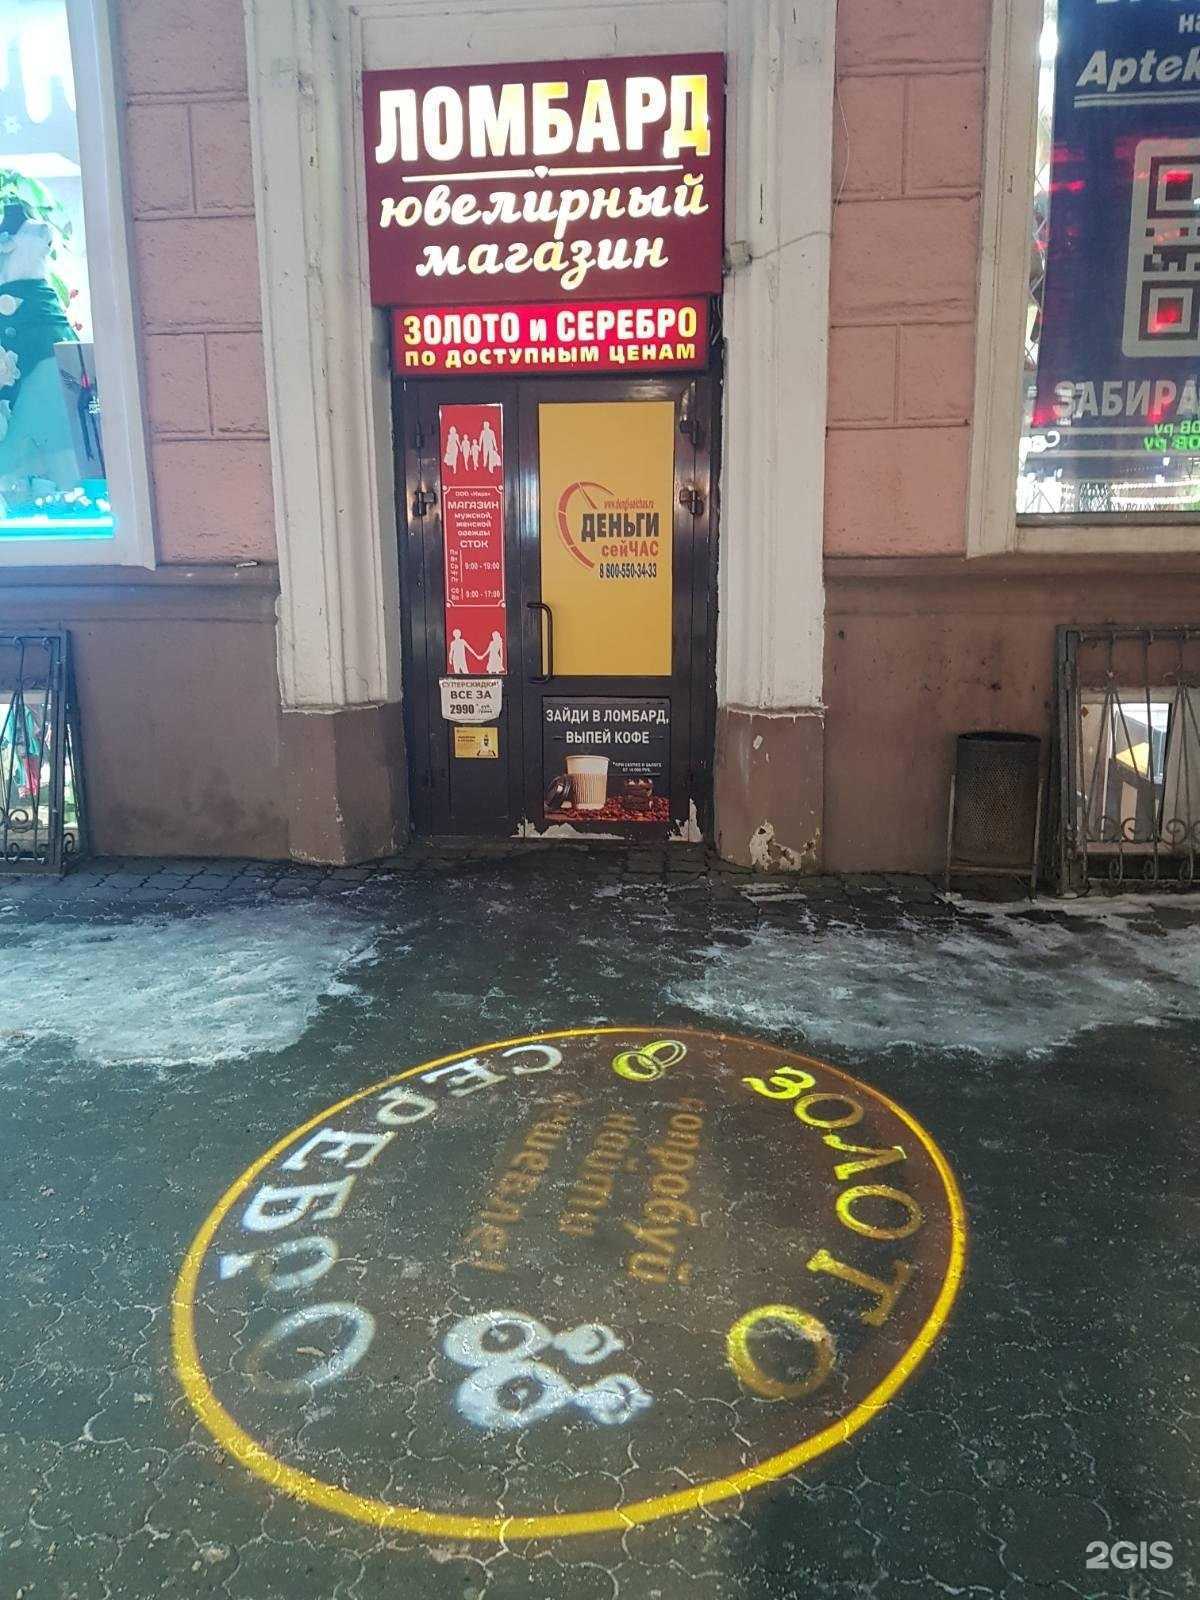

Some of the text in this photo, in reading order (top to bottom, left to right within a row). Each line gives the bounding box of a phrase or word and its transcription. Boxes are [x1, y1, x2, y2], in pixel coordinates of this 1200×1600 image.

[1178, 14, 1200, 34] н
[375, 74, 711, 164] ЛОМБАРД
[380, 173, 709, 240] ювелирный
[416, 237, 669, 291] магазин
[403, 307, 697, 345] ЗОЛОТО и СЕРЕБРО
[405, 343, 695, 368] ПО ДОСТУПНЫМ ЦЕНАМ
[1053, 380, 1200, 418] ЗАБИРА
[447, 501, 499, 510] МАГАЗИН
[581, 512, 659, 542] ДЕНЬГИ
[460, 540, 489, 548] СТОК
[601, 540, 659, 557] сейЧАС
[606, 563, 657, 578] 800-550-34-33
[450, 691, 492, 699] ВСЕ ЗА
[450, 704, 475, 714] 2990
[546, 706, 669, 724] ЗАЙДИ В ЛОМБАРД,
[566, 729, 649, 743] ВЫПЕЙ КОФЕ
[219, 1043, 564, 1394] СЕРЕБРО
[727, 1066, 923, 1398] ЗОЛОТО
